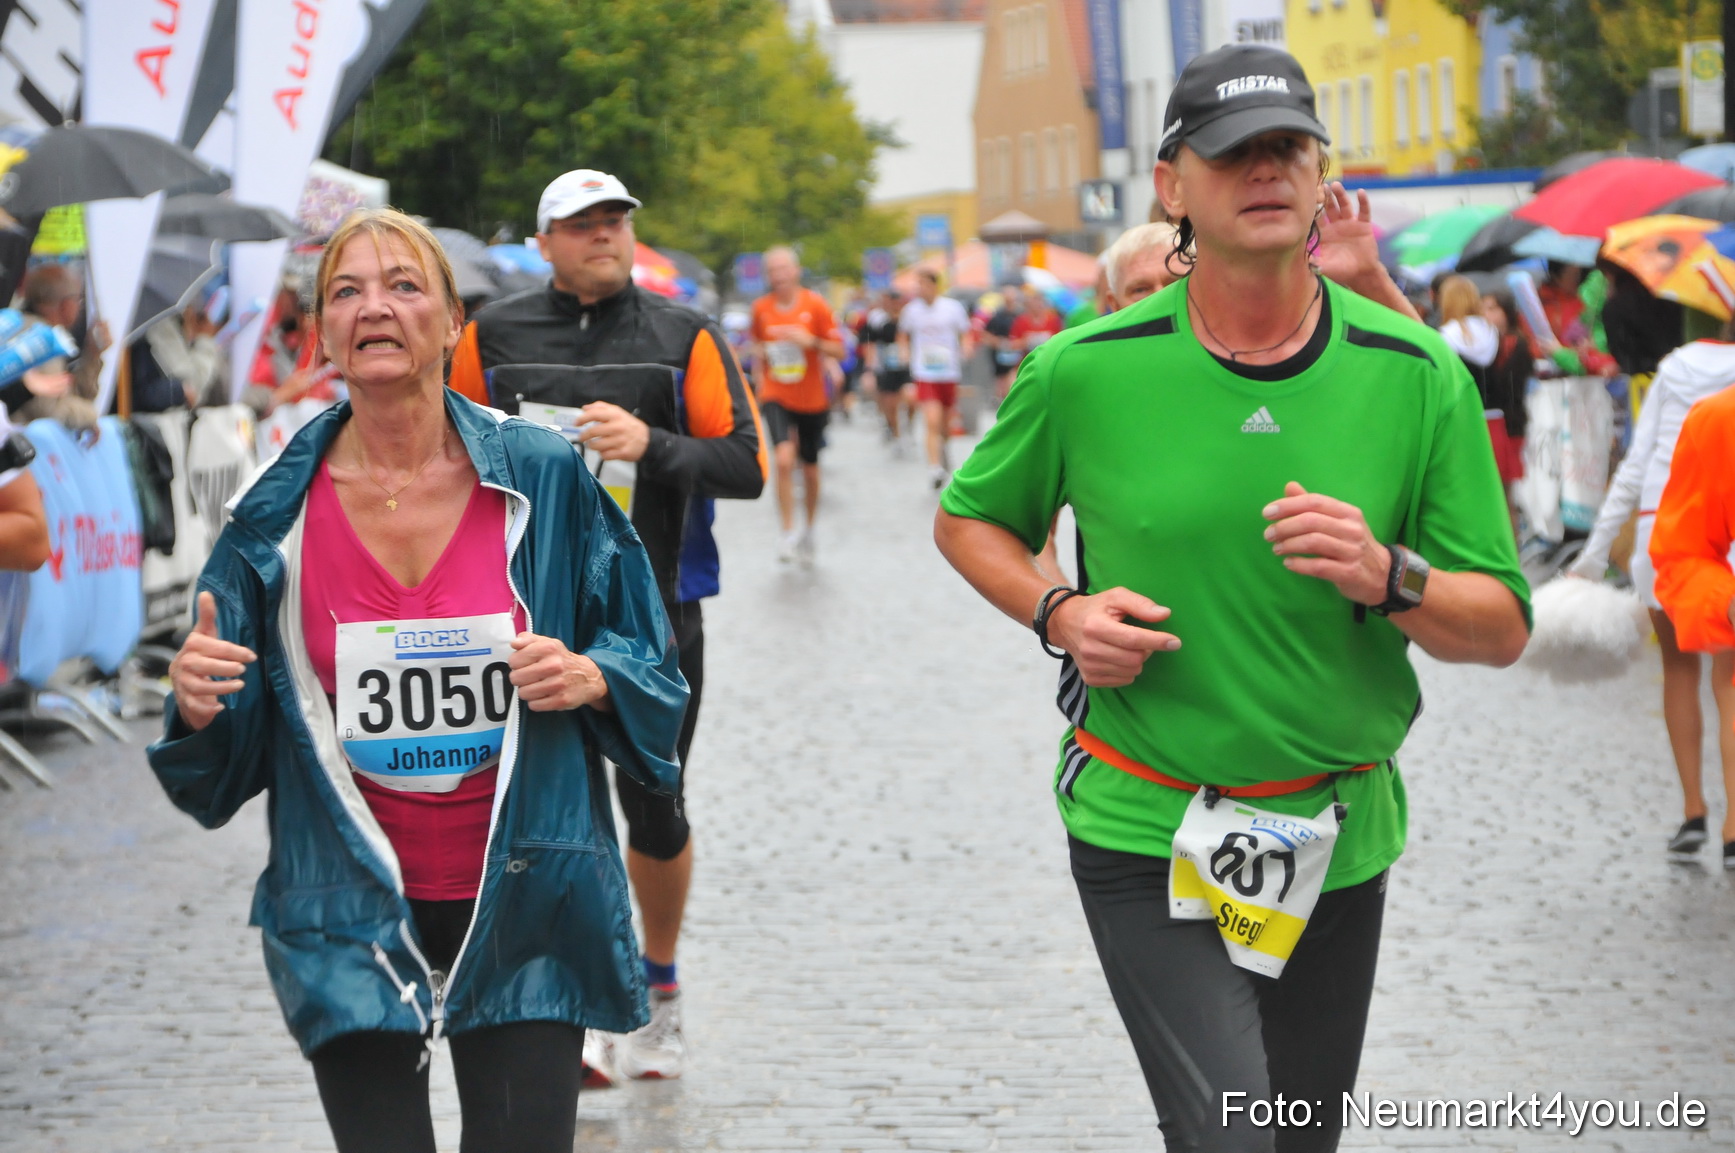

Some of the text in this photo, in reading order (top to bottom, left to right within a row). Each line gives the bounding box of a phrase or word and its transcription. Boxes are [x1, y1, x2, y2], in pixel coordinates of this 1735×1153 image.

[272, 0, 324, 131] Aud
[1216, 75, 1291, 101] TRISTAR
[1241, 422, 1281, 433] adidas
[395, 629, 470, 649] BOCK
[357, 661, 515, 734] 3050
[387, 743, 491, 771] Johanna
